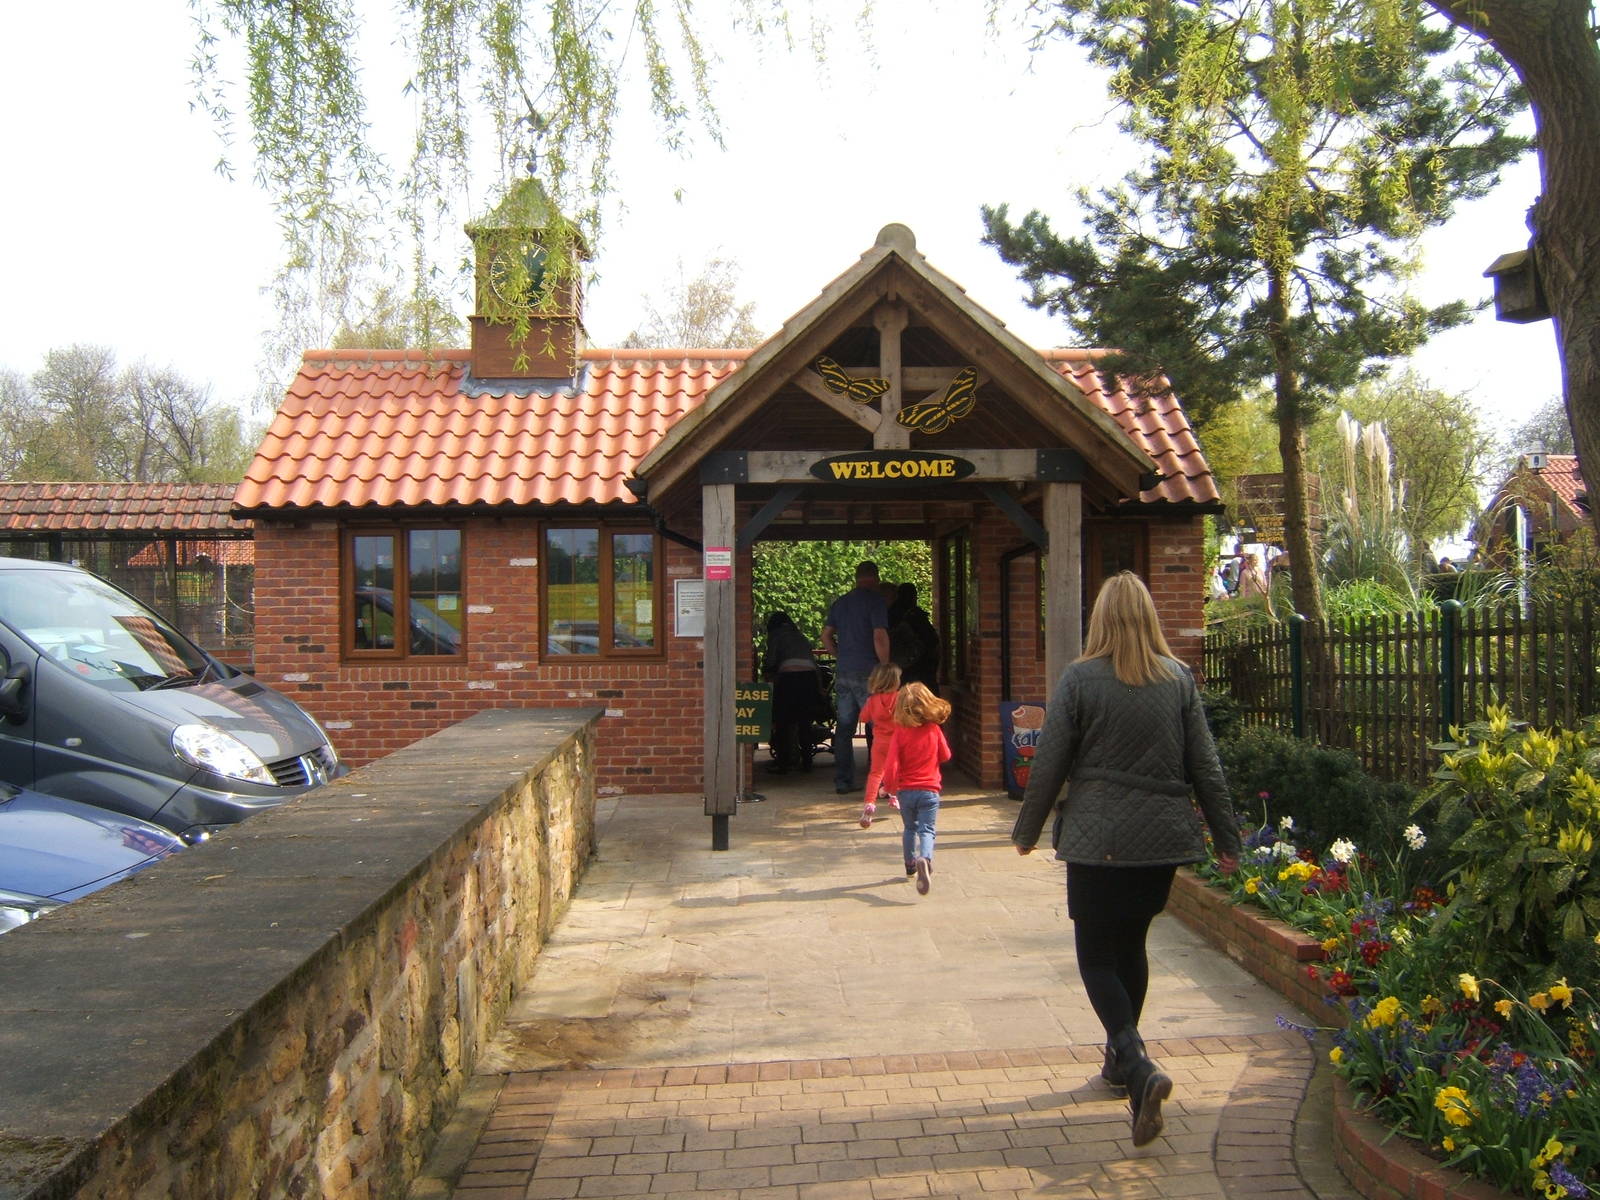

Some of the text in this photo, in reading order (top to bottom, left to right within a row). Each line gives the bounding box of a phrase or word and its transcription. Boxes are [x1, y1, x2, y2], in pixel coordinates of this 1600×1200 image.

[829, 459, 956, 480] WELCOME
[735, 690, 769, 701] EASE
[735, 707, 756, 718] AY
[735, 725, 760, 735] ERE
